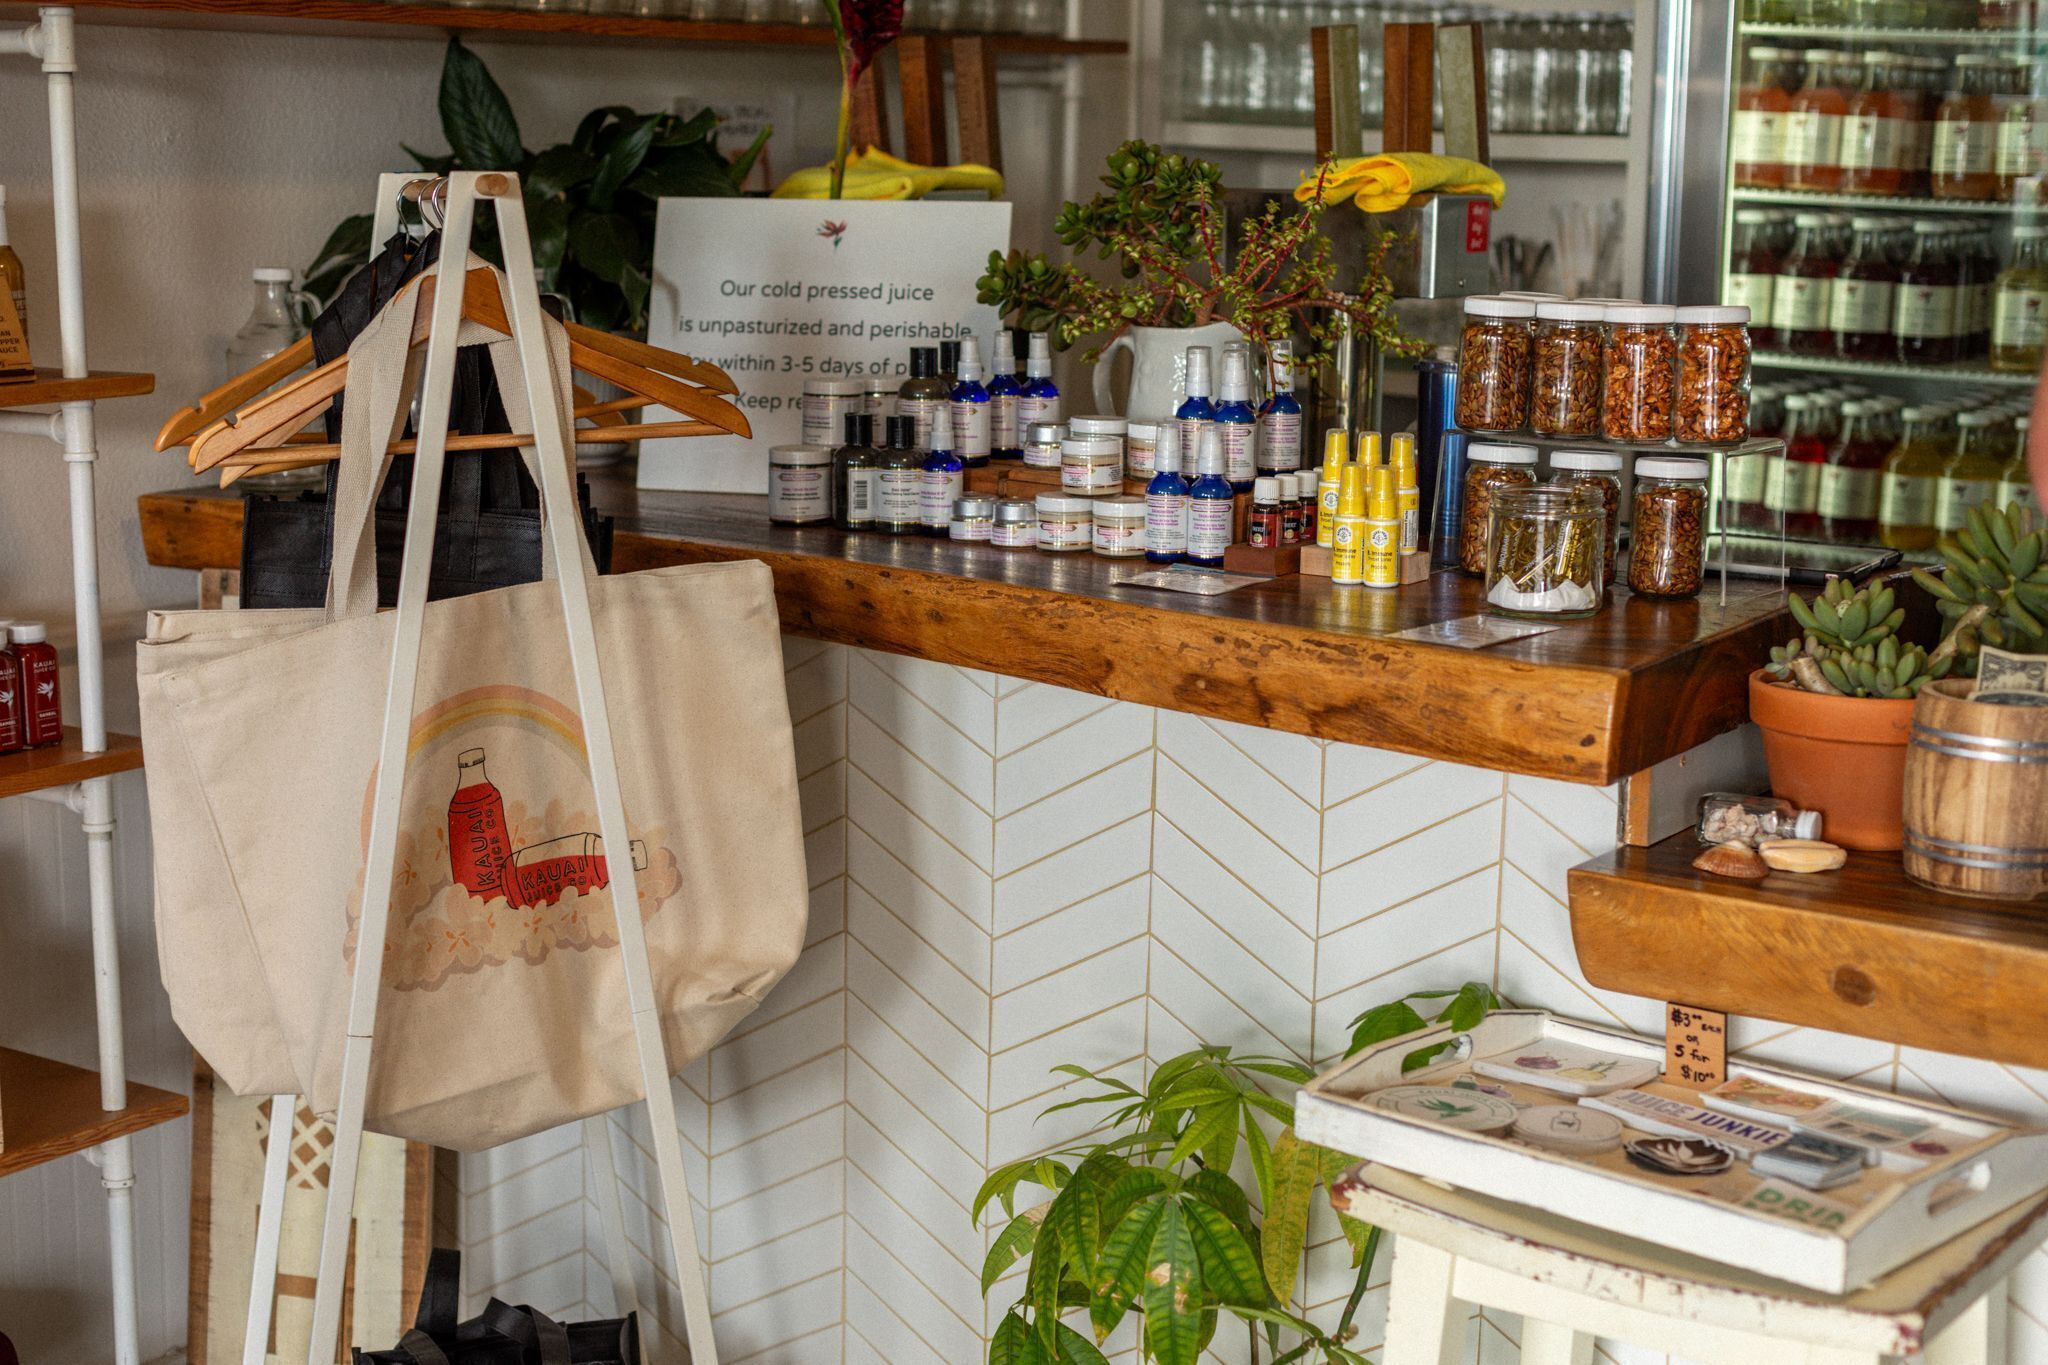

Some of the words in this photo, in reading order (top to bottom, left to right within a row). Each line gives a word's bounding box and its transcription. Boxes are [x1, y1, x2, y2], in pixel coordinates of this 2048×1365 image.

[719, 279, 756, 297] Our
[760, 280, 802, 298] cold
[807, 282, 883, 302] pressed
[887, 283, 935, 305] juice
[679, 315, 694, 333] is
[698, 318, 823, 338] unpasturized
[828, 320, 864, 337] and
[869, 321, 972, 342] perishable
[718, 354, 776, 371] within
[780, 355, 814, 373] 3-5
[819, 356, 864, 378] days
[869, 357, 890, 375] of
[735, 391, 782, 413] Keep
[467, 809, 497, 887] KAUAI
[521, 857, 586, 891] KAUAI
[1674, 1044, 1685, 1058] 5
[1615, 1091, 1695, 1118] JUICE
[1687, 1111, 1787, 1145] JUNKIE
